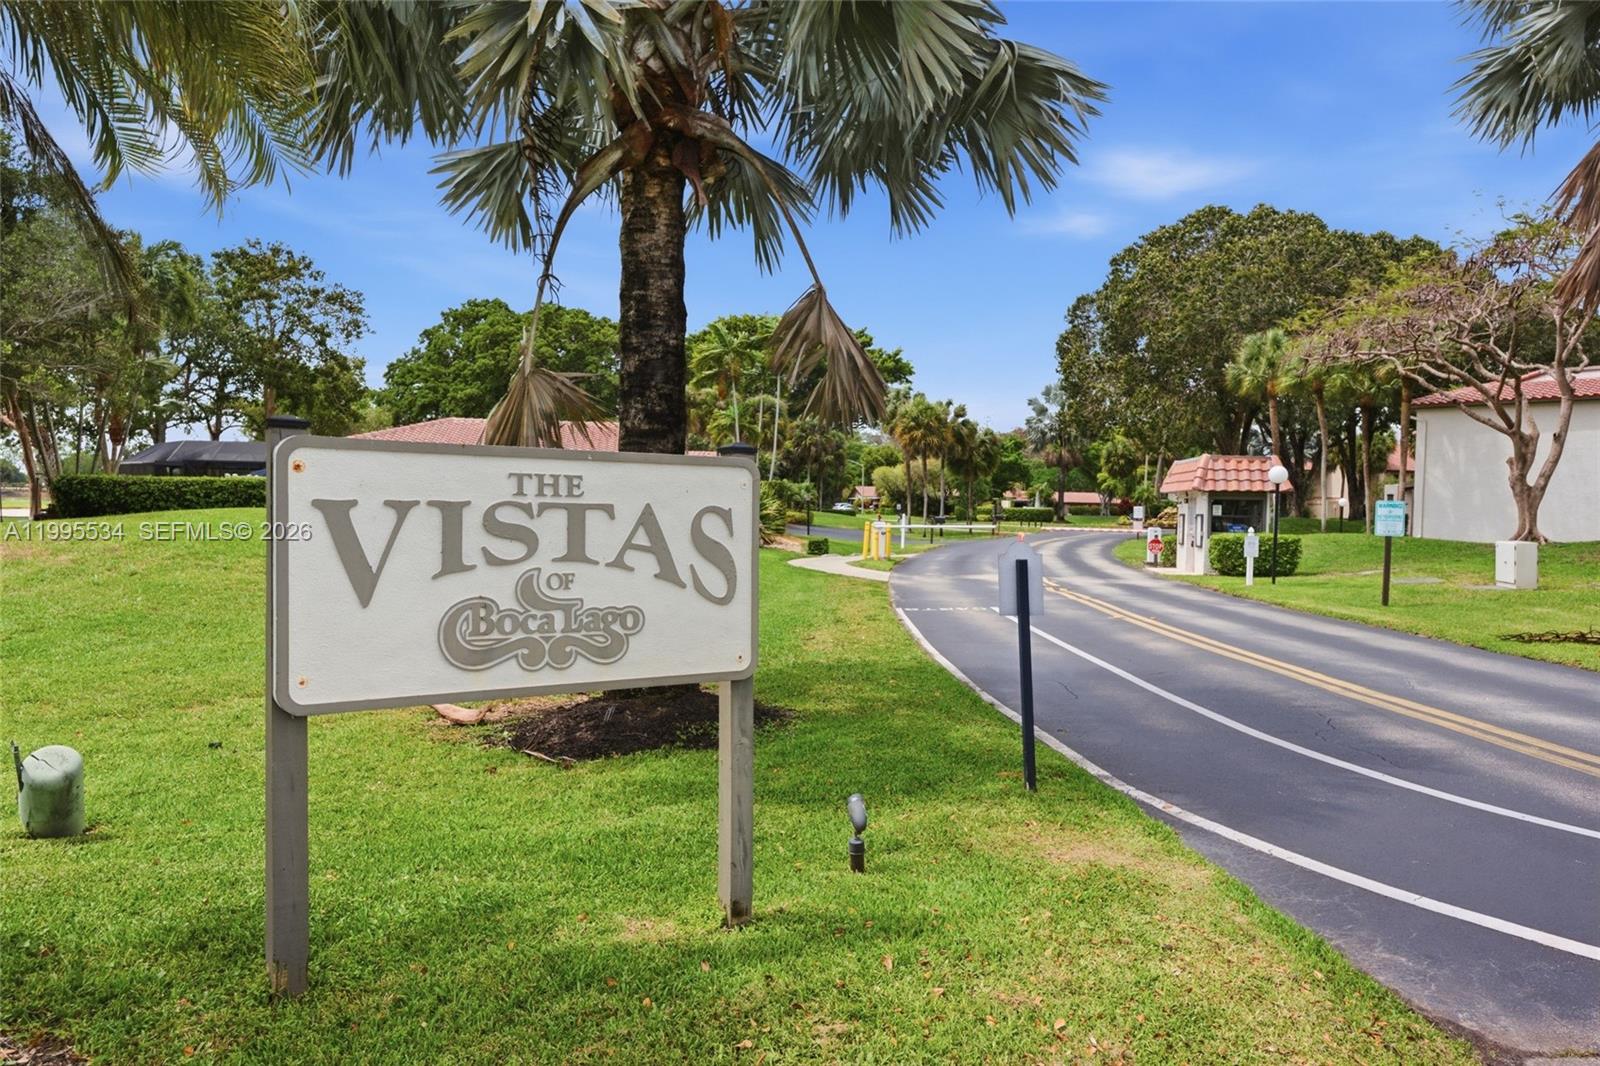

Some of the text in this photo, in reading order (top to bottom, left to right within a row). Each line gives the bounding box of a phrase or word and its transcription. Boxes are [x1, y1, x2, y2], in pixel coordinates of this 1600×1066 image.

[508, 473, 585, 498] THE
[311, 498, 737, 609] VISTAS
[546, 572, 576, 591] OF
[467, 602, 640, 637] Boca Lago
